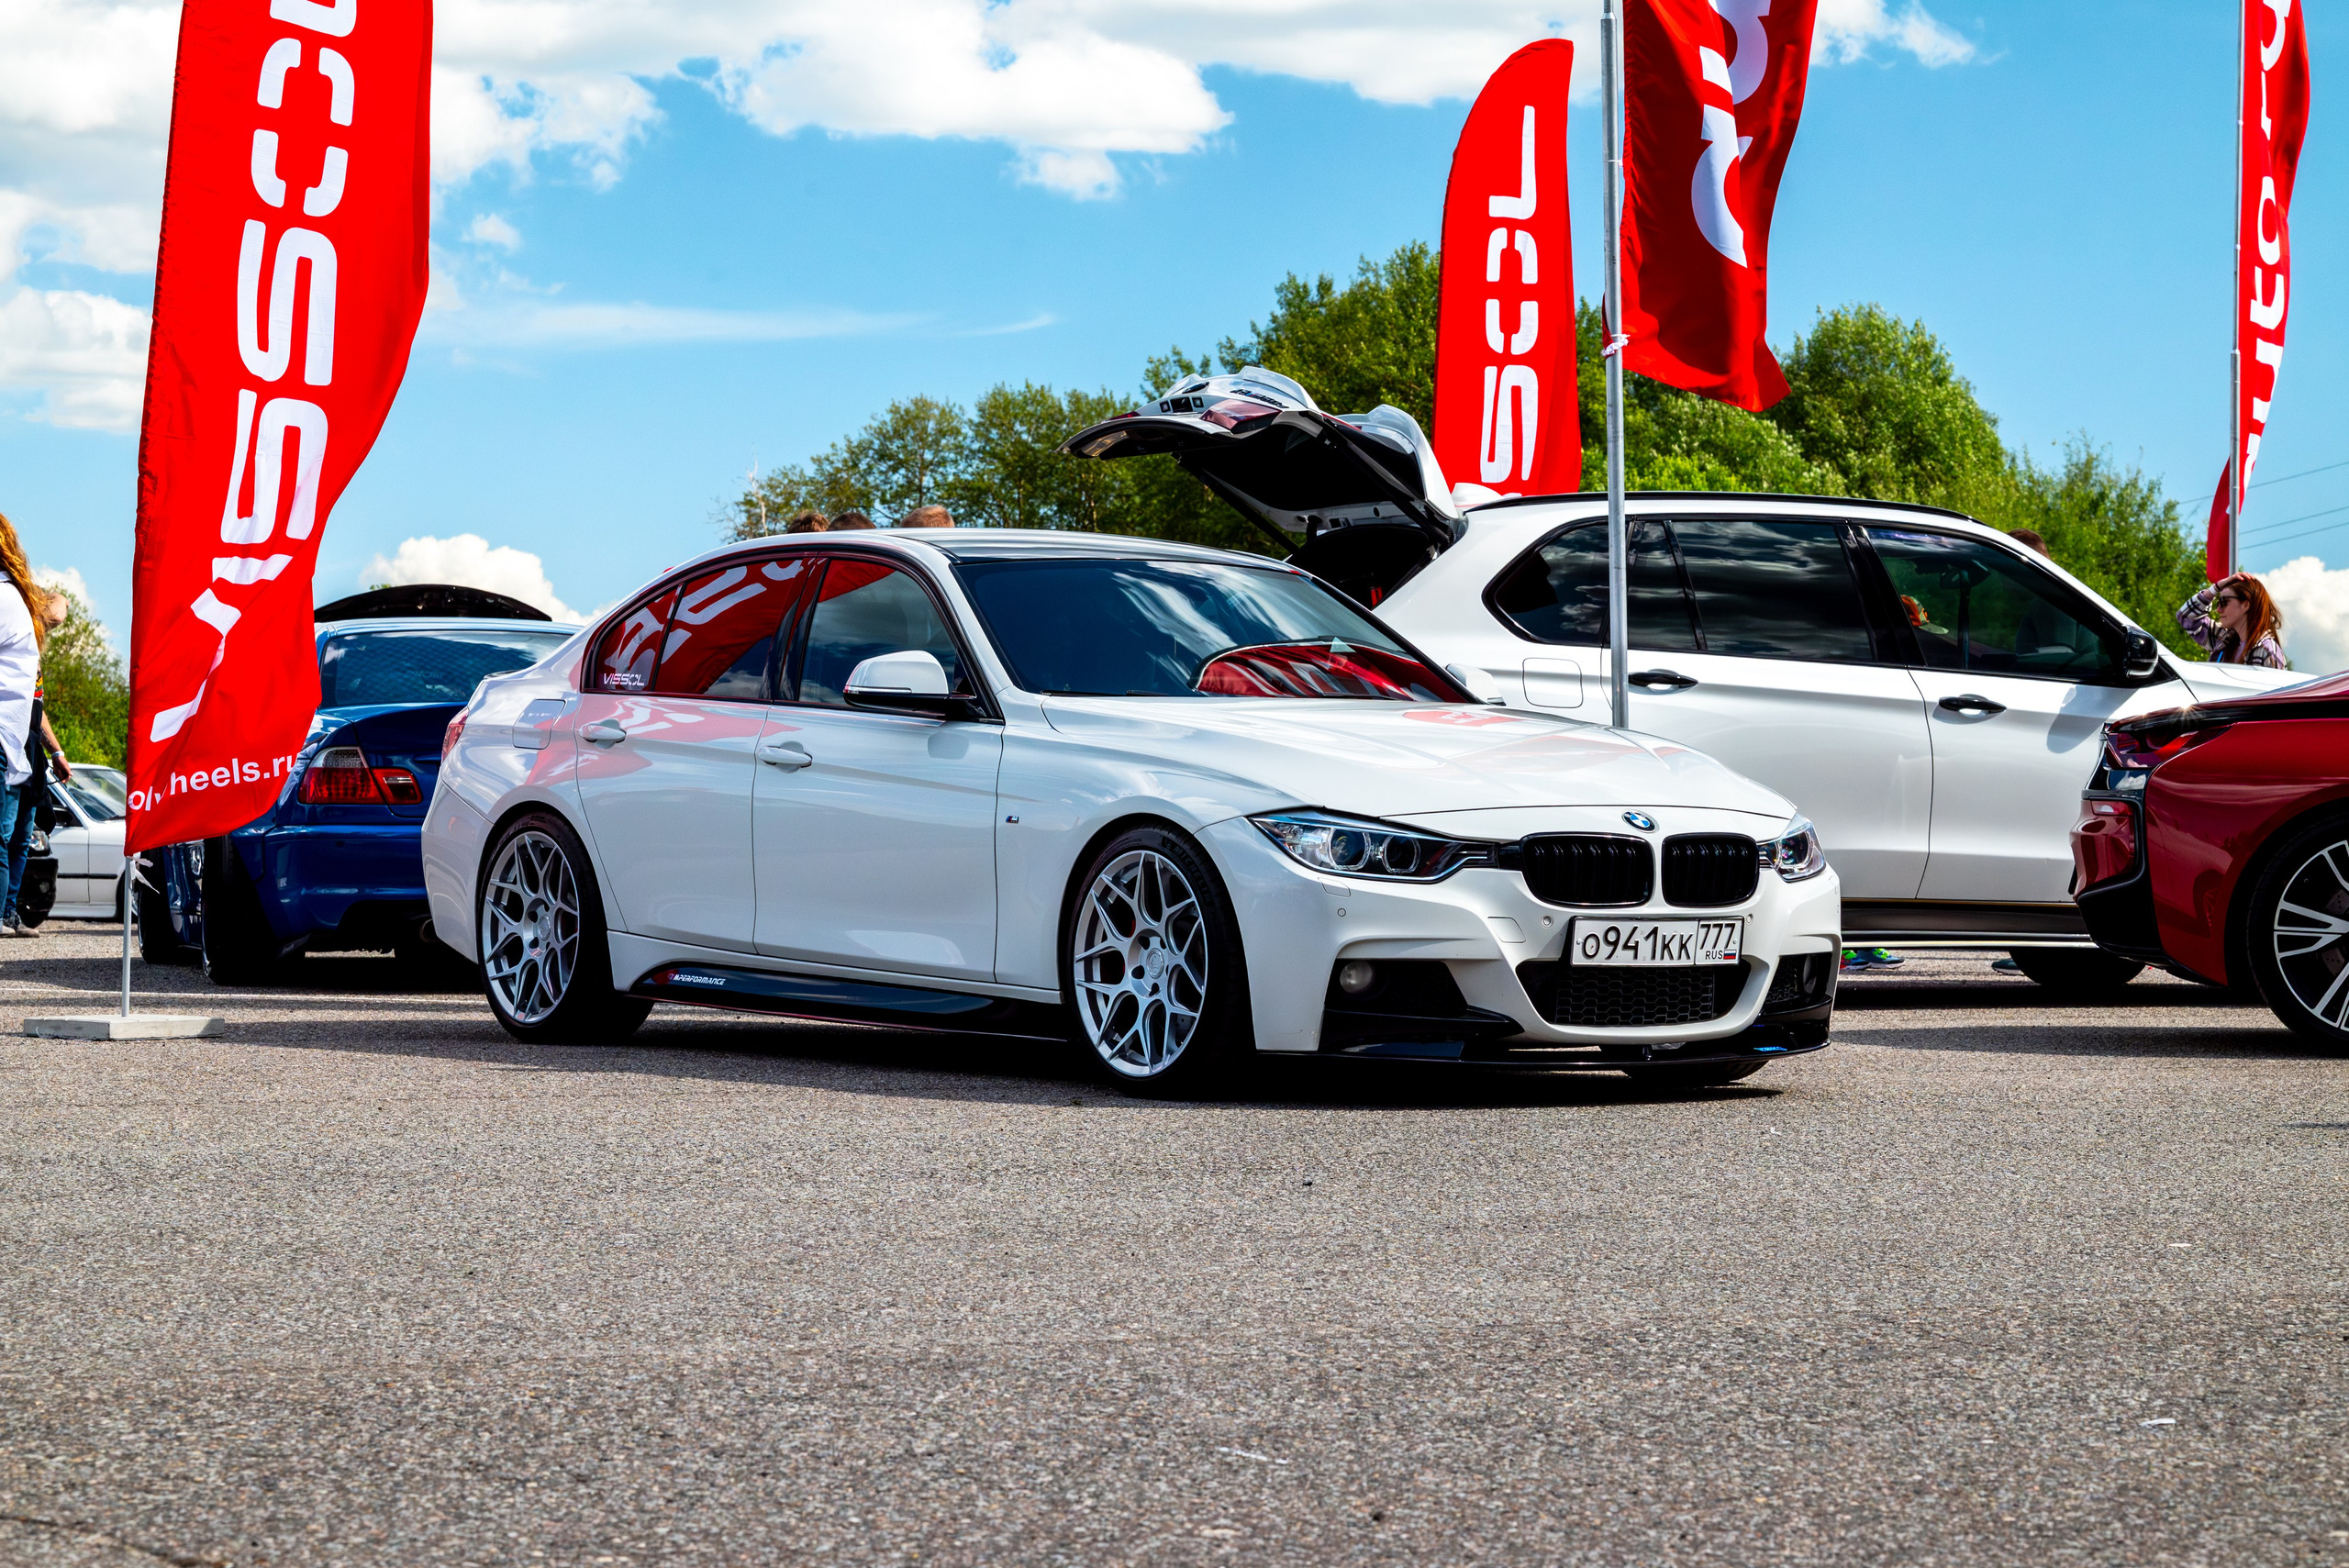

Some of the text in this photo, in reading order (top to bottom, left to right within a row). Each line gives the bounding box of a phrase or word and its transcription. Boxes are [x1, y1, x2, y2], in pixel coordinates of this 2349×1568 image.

[1479, 106, 1540, 496] SOL
[603, 673, 645, 686] VISSOL
[1699, 923, 1736, 951] 777
[1705, 950, 1723, 961] RUS
